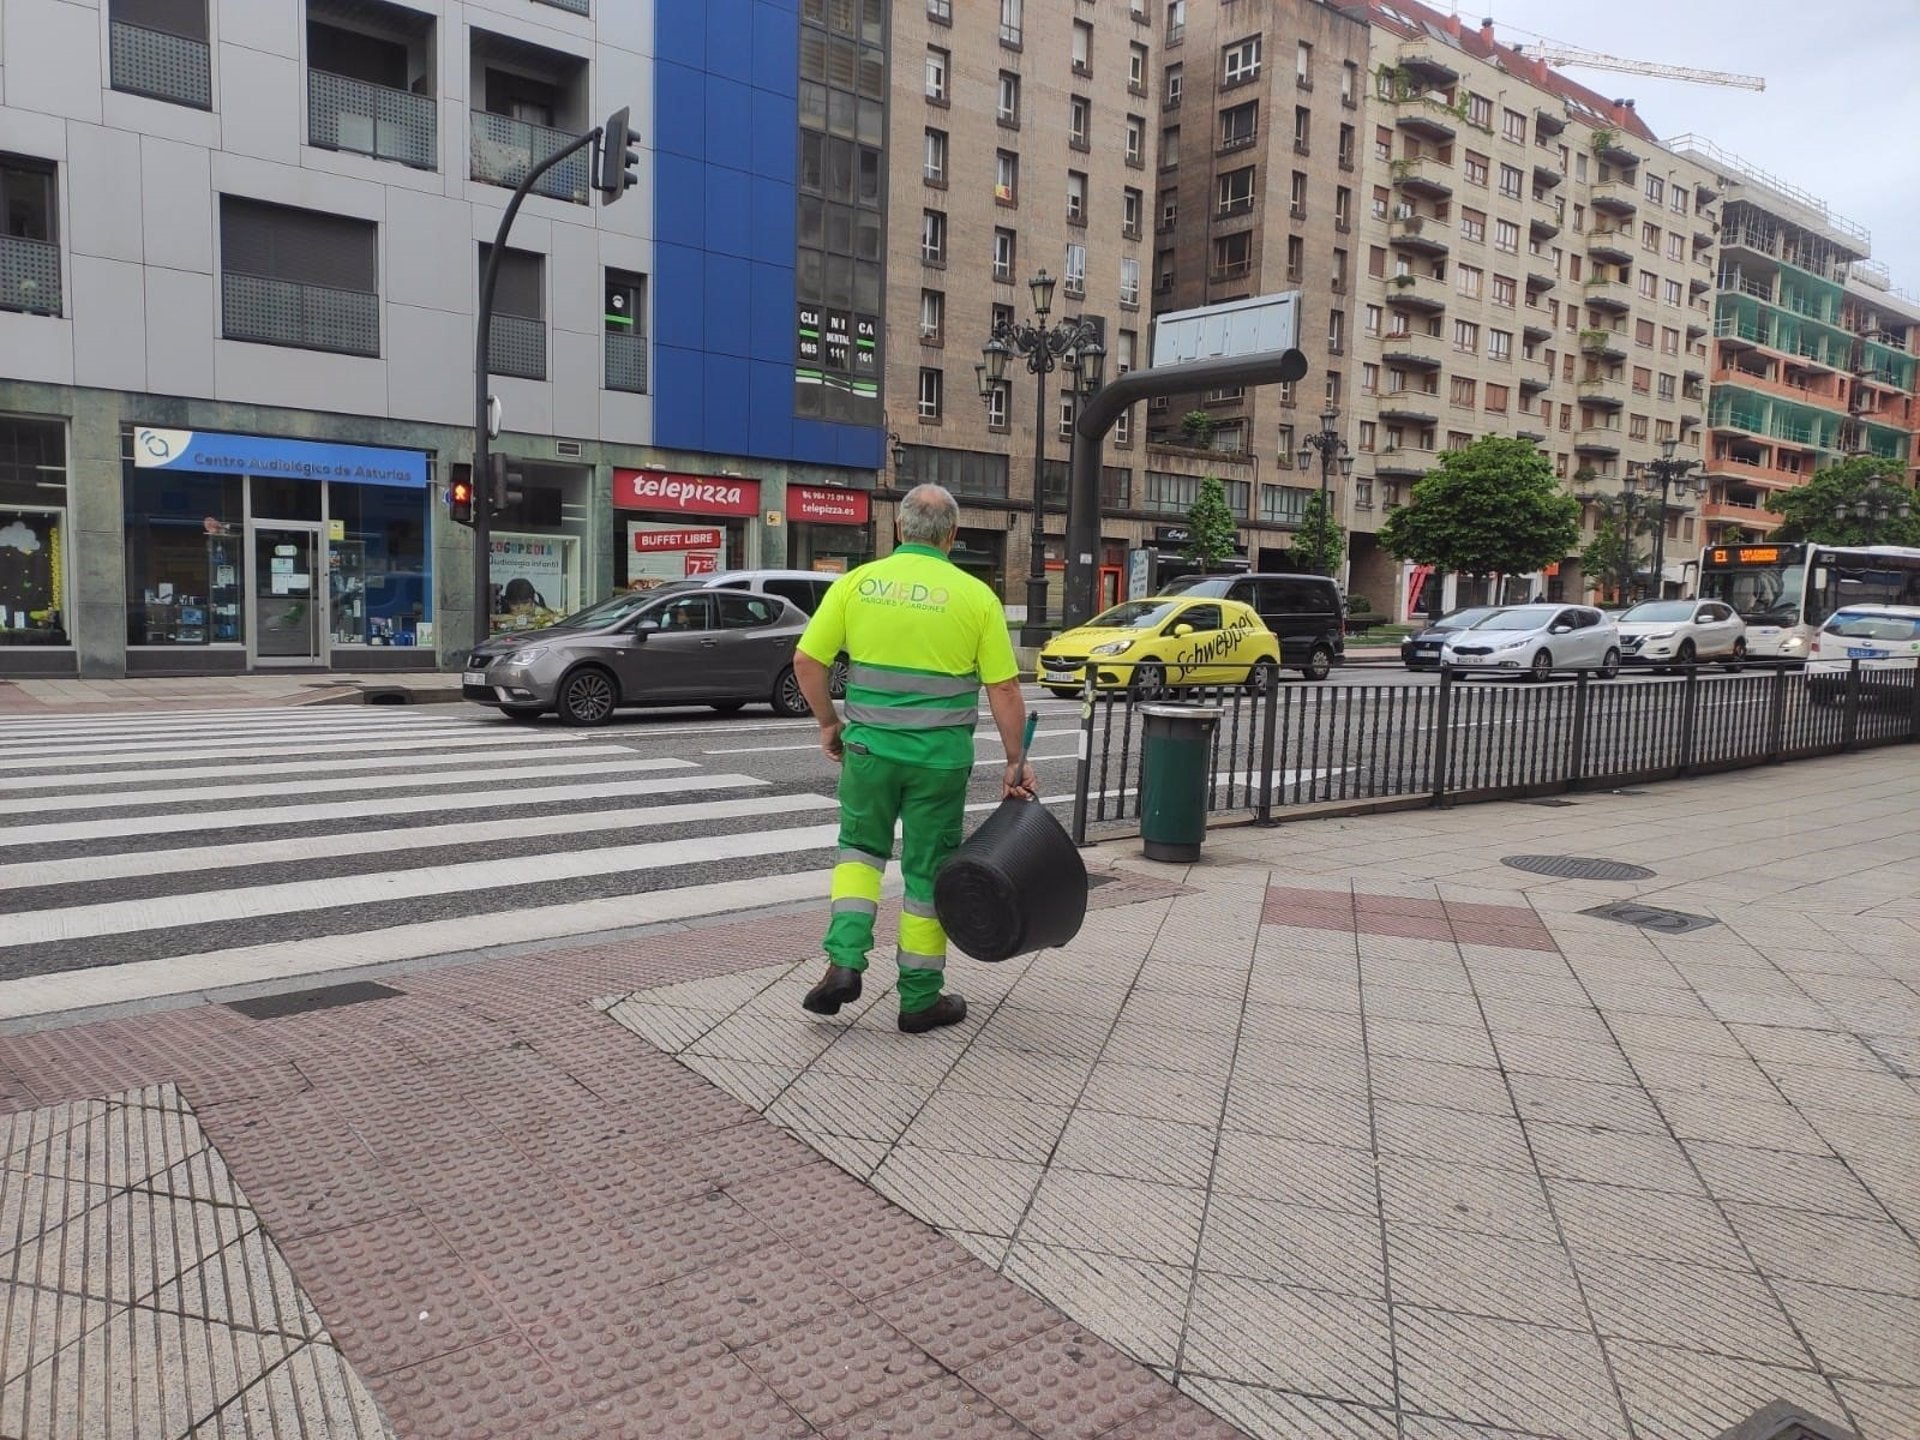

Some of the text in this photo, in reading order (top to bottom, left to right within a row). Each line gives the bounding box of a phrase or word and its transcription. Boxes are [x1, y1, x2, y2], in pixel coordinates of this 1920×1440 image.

[801, 311, 818, 325] CLI
[858, 322, 874, 336] CA
[826, 332, 849, 345] DENTAL
[829, 347, 845, 359] 111
[857, 351, 873, 364] 161
[193, 452, 412, 482] Centro Audiológico de Asturias
[633, 475, 741, 507] telepizza
[802, 503, 855, 516] telepizza.es
[641, 533, 713, 546] BUFFET LIBRE
[858, 578, 950, 605] OVIEDO
